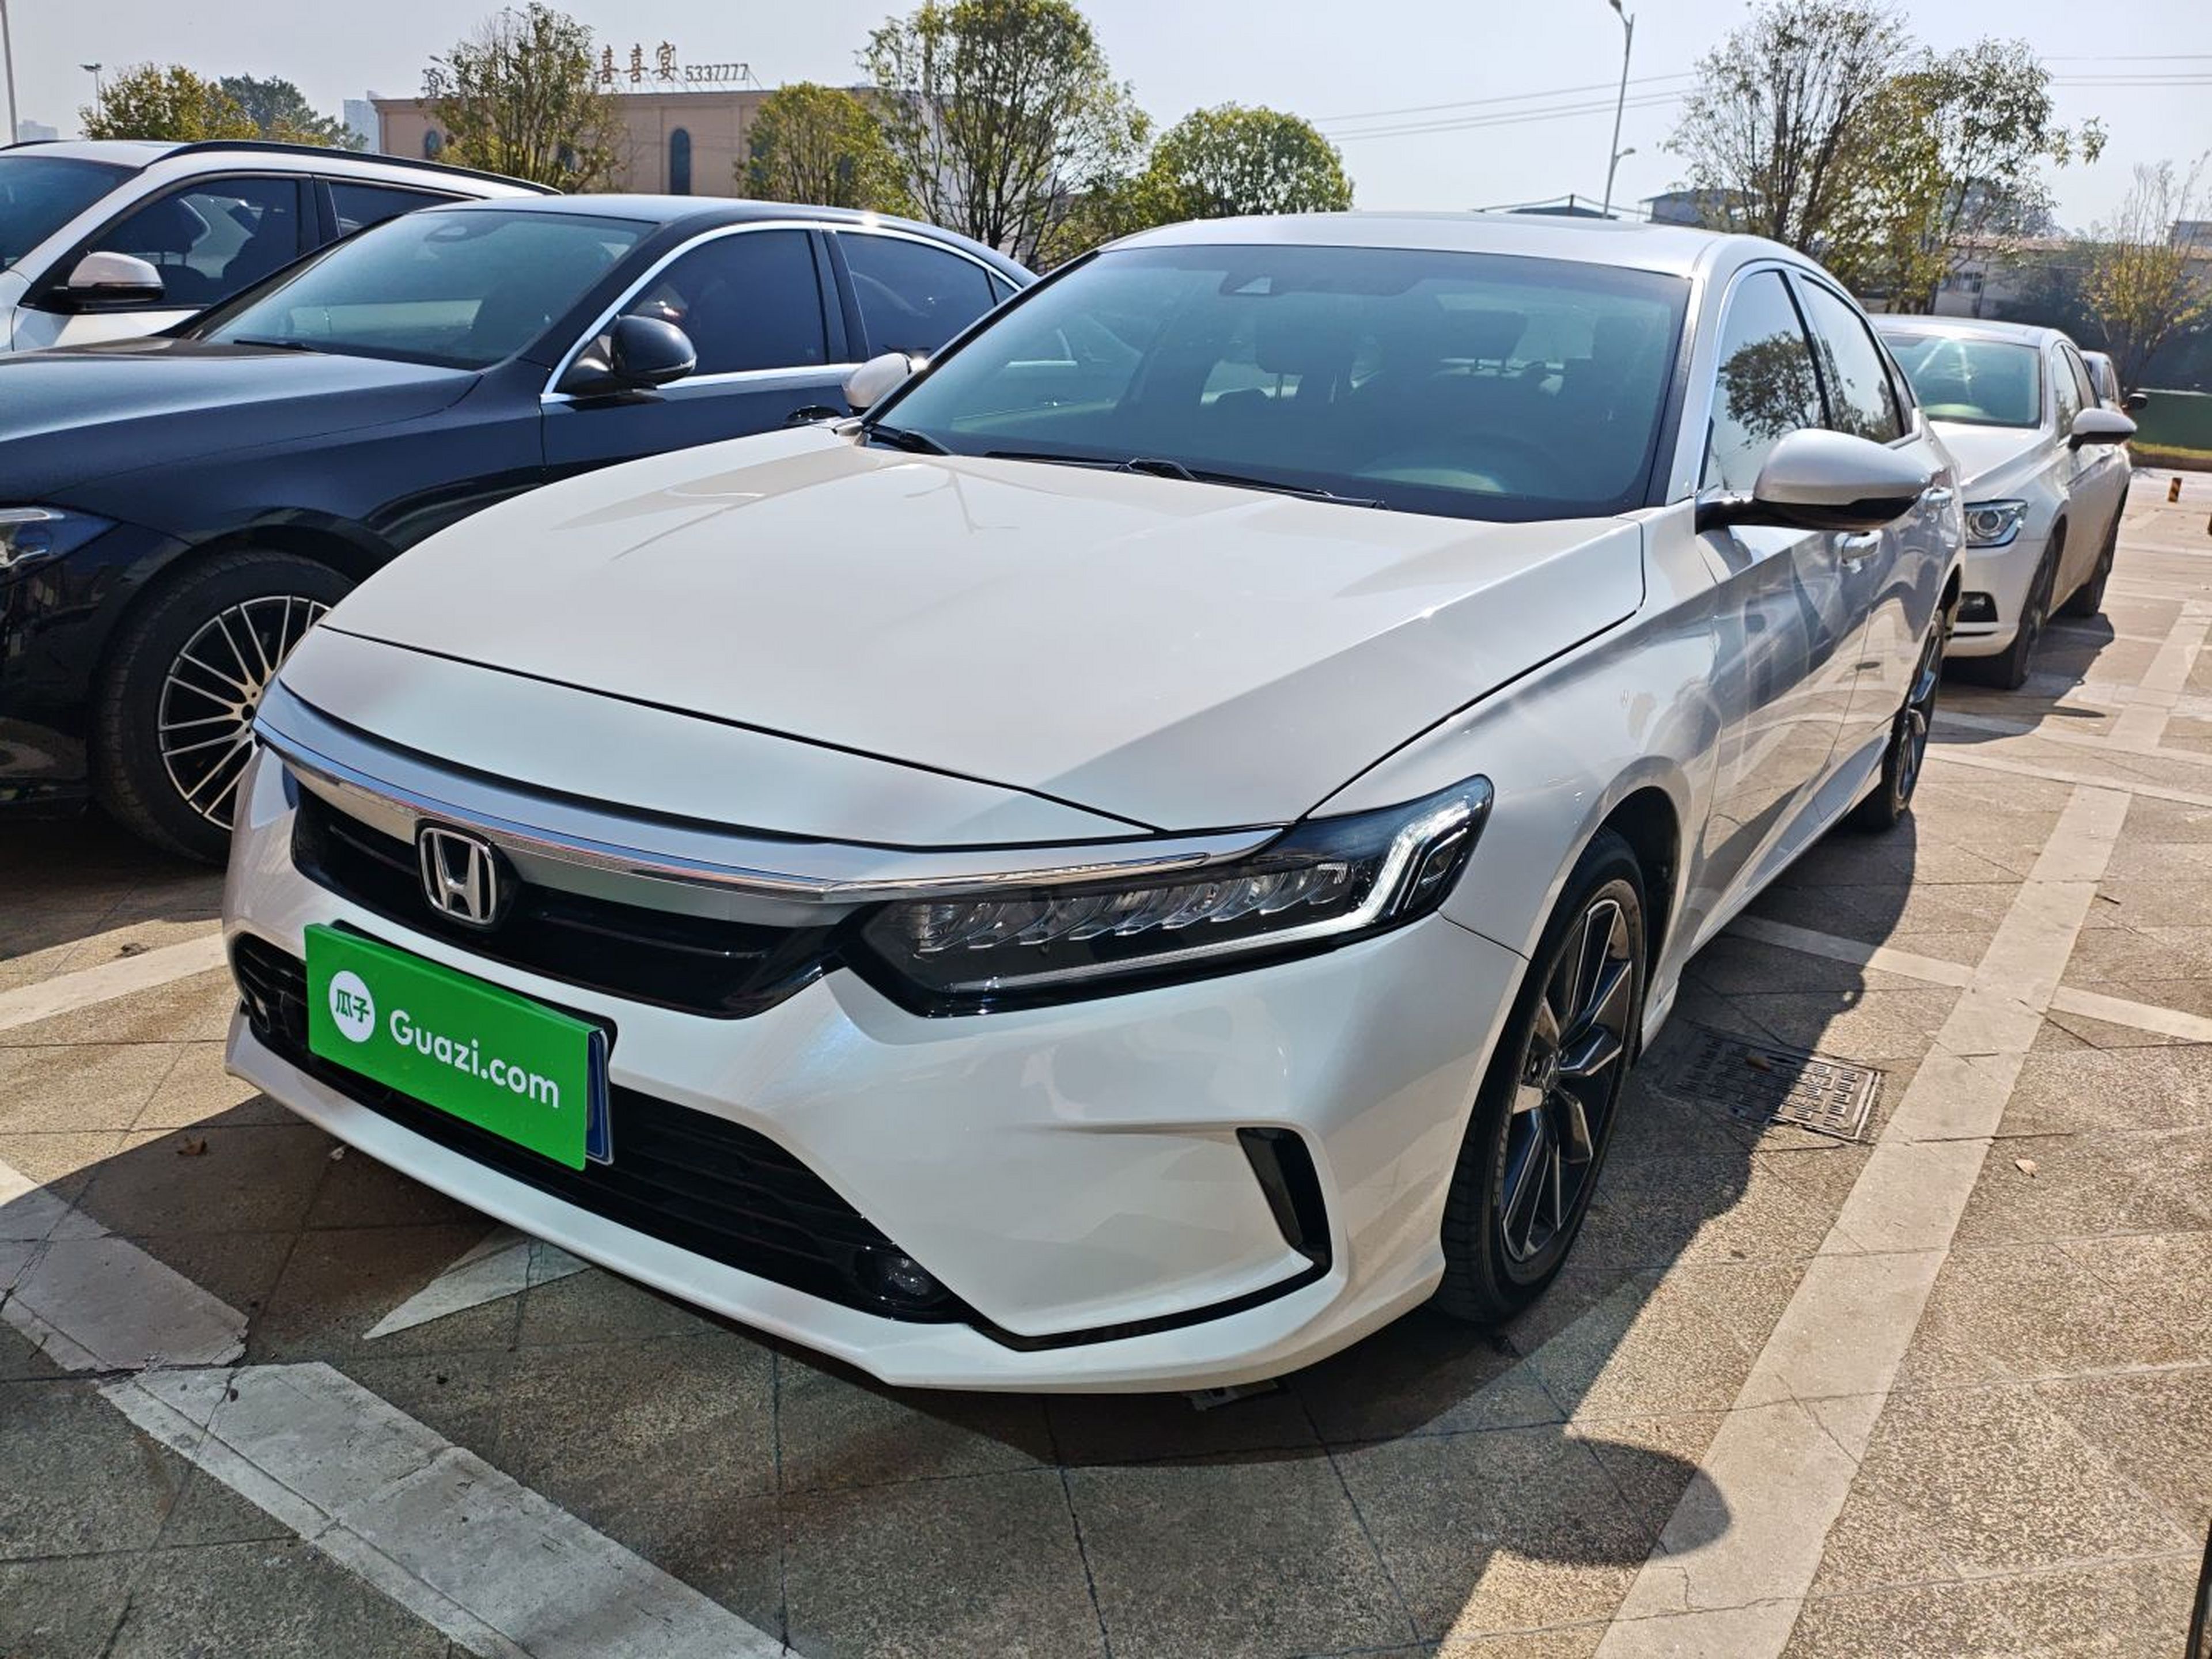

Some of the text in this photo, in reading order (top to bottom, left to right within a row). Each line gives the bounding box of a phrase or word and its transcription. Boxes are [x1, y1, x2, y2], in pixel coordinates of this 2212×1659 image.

[685, 64, 748, 82] 5337777
[335, 988, 370, 1023] 瓜子
[389, 1009, 559, 1108] Guazi.com
